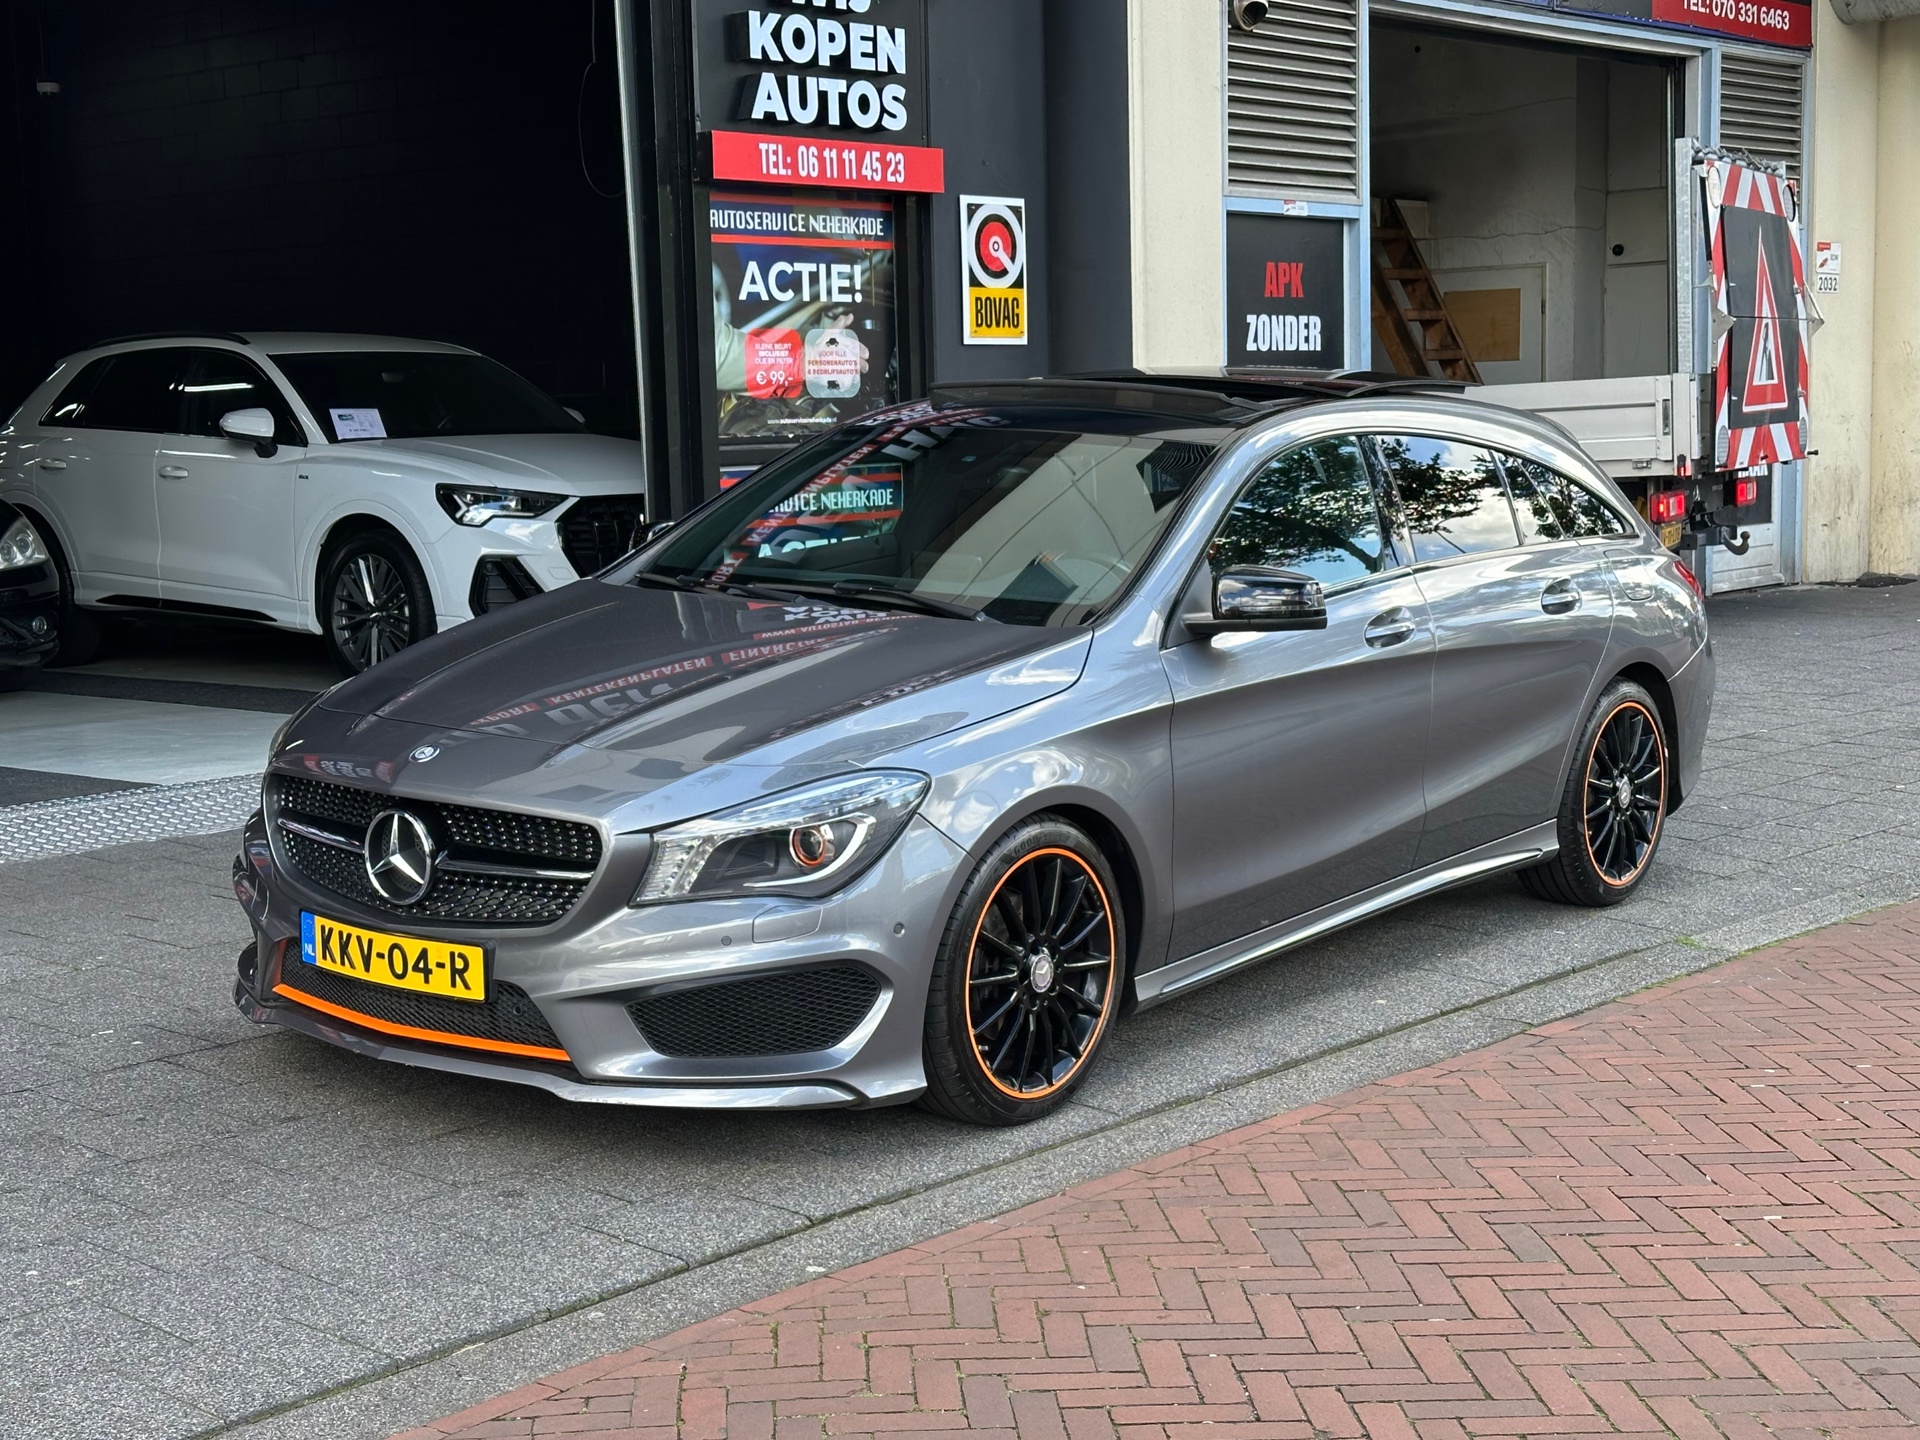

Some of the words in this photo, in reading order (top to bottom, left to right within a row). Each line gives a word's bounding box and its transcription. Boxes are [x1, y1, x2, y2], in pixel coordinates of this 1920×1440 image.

[1712, 0, 1736, 20] 070
[1738, 1, 1758, 25] 331
[1760, 6, 1790, 31] 6463
[748, 10, 907, 75] KOPEN
[751, 72, 908, 131] AUTOS
[758, 142, 792, 176] TEL:
[797, 145, 819, 178] 06
[823, 147, 838, 179] 11
[842, 148, 857, 180] 11
[861, 150, 882, 182] 45
[886, 151, 905, 183] 23
[710, 209, 806, 232] AUTOSERVICE
[809, 214, 884, 236] NEHERKADE
[738, 260, 863, 303] ACTIE!
[1264, 261, 1305, 298] APK
[1818, 276, 1838, 291] 2032
[974, 296, 1020, 329] BOVAG
[1246, 313, 1322, 352] ZONDER
[756, 371, 767, 385] €
[769, 370, 794, 387] 99,-
[820, 488, 894, 510] NEHERKADE
[304, 942, 315, 957] NL
[320, 923, 472, 992] KKV-04-R
